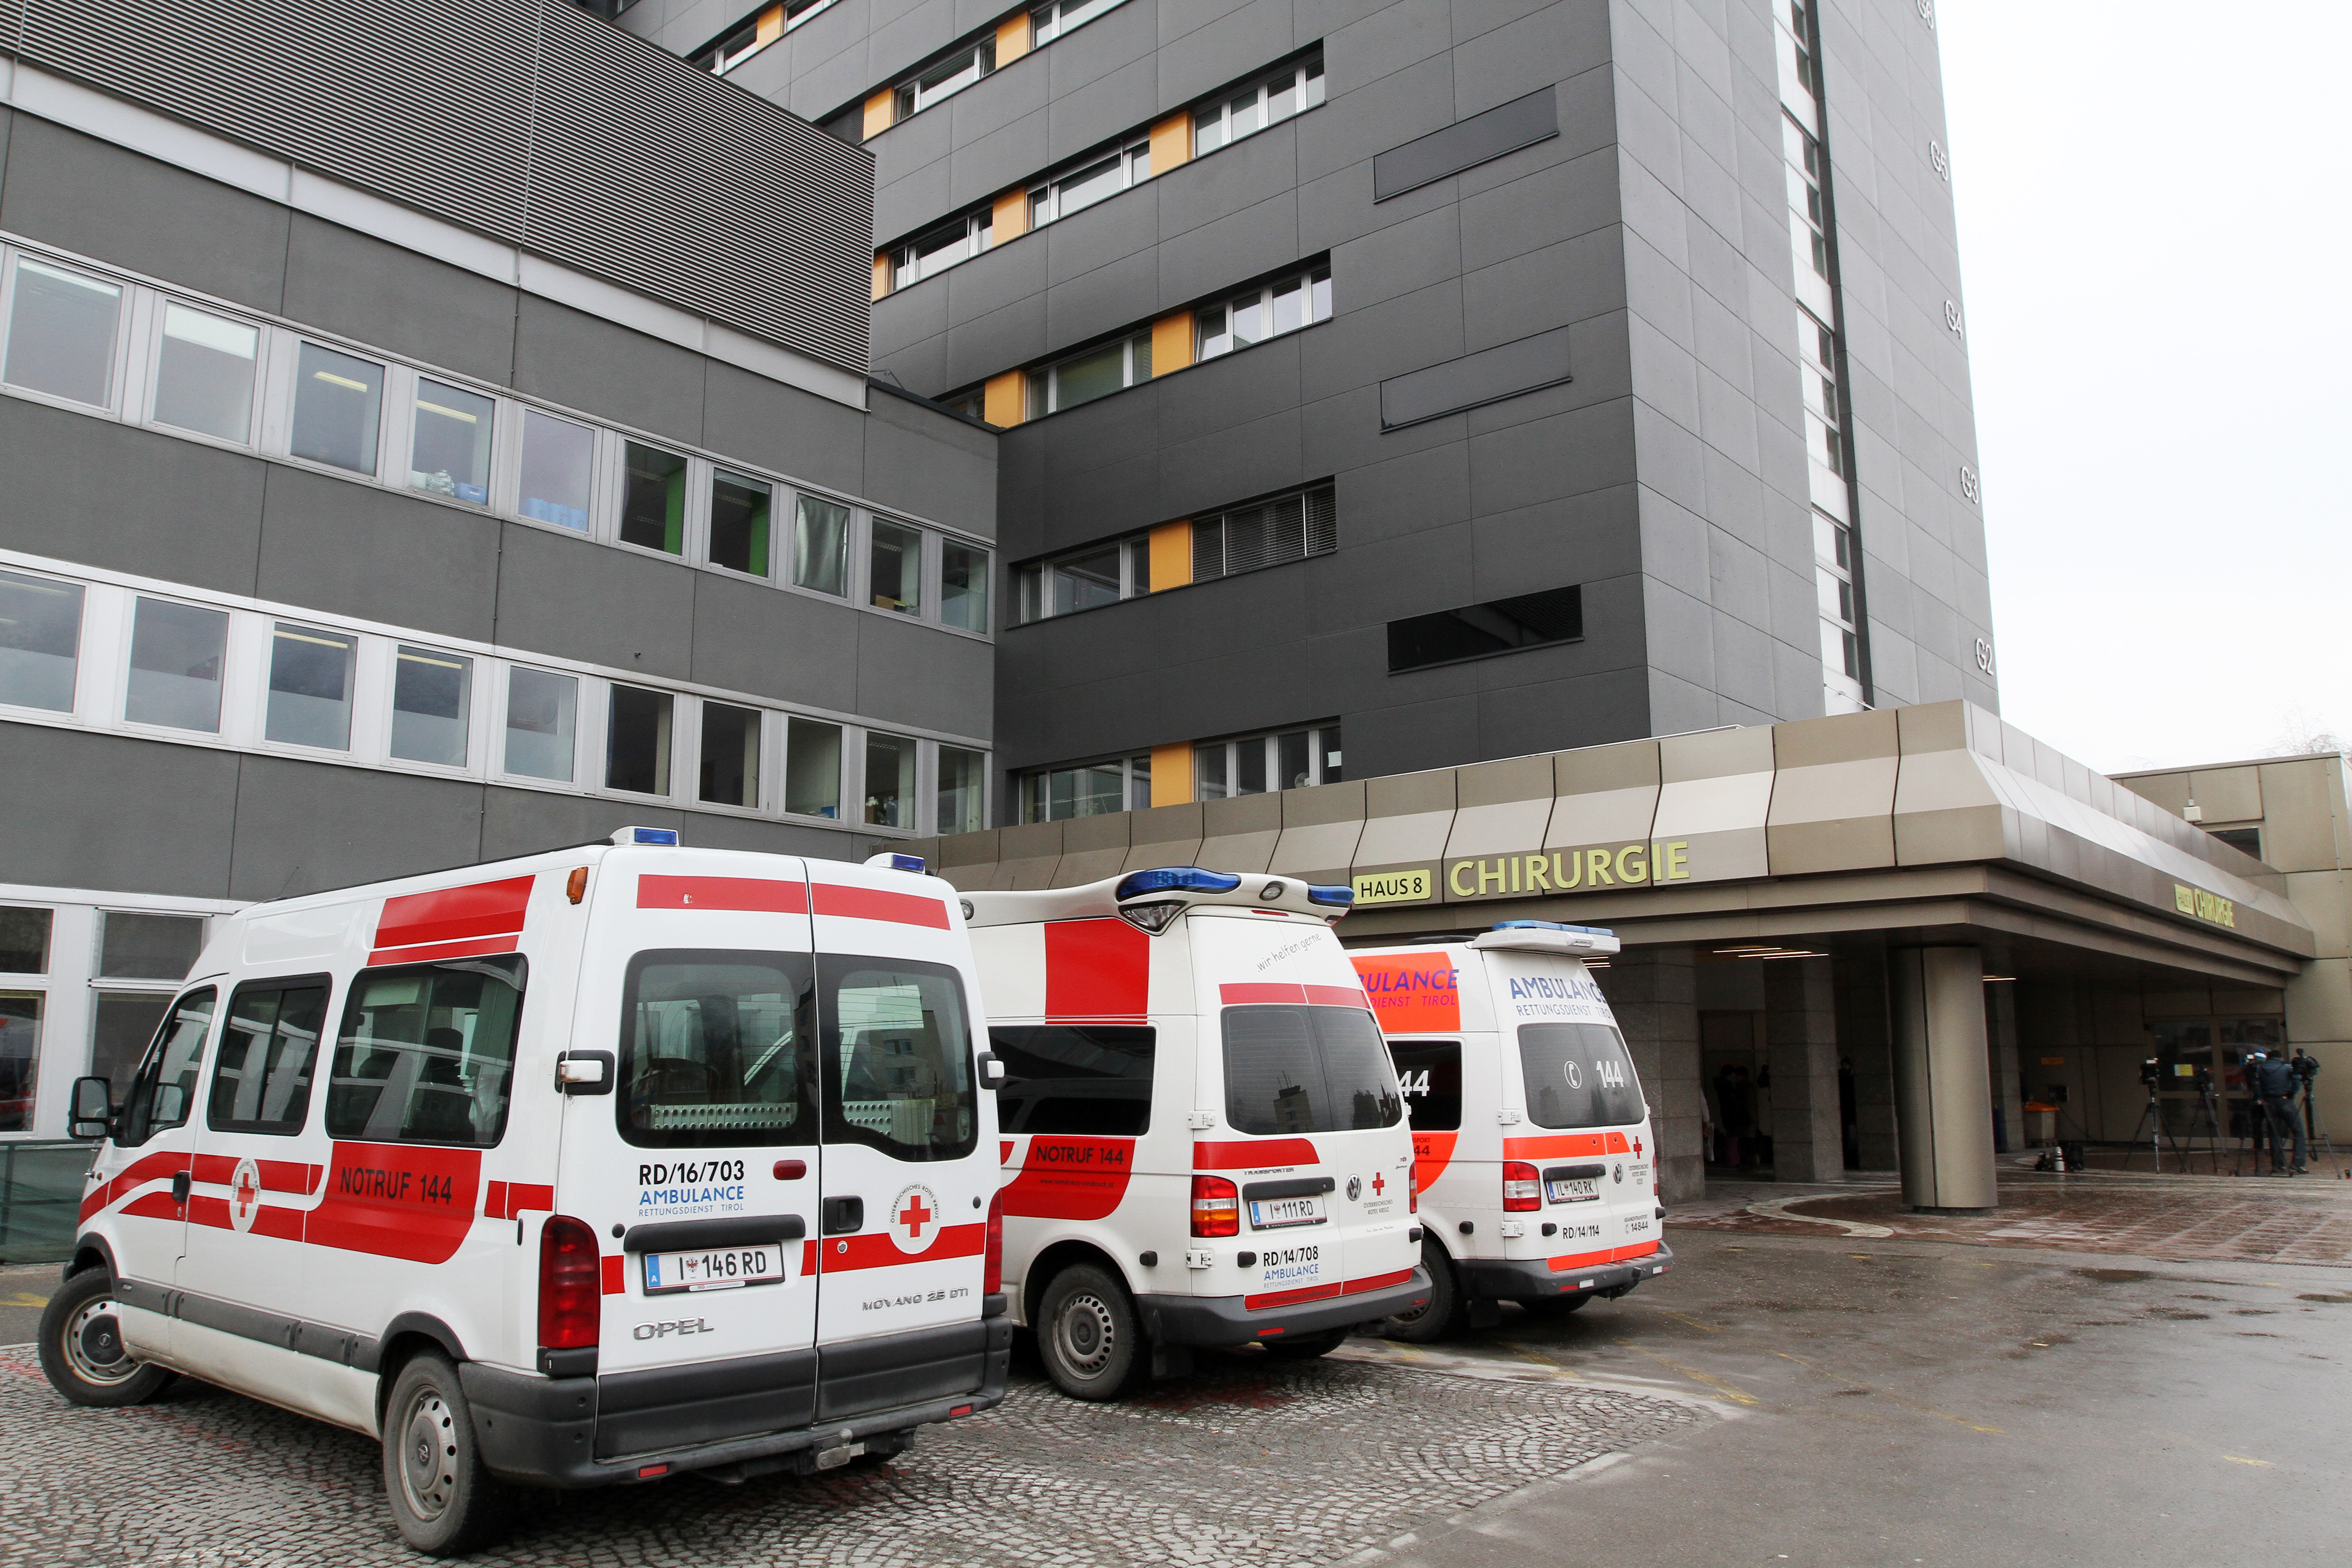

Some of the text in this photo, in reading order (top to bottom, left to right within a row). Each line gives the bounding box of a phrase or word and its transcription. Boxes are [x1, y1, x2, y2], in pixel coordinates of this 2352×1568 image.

[1930, 141, 1948, 181] G5
[1945, 300, 1962, 339] G4
[1961, 466, 1979, 504] G3
[1975, 638, 1994, 676] G2
[1450, 841, 1690, 897] CHIRURGIE
[1361, 877, 1422, 897] HAUS 8
[1271, 944, 1301, 962] helfen
[1300, 933, 1322, 951] gerne
[1422, 995, 1456, 1006] TIROL
[1509, 977, 1607, 1004] AMBULANCE
[1516, 1004, 1592, 1016] RETTUNGSDIENST
[1596, 1060, 1624, 1088] 144
[1036, 1146, 1124, 1165] NOTRUF 144
[639, 1160, 744, 1186] RD/16/703
[340, 1166, 452, 1205] NOTRUF 144
[639, 1186, 744, 1205] AMBULANCE
[1556, 1180, 1594, 1196] IL 140 RK
[639, 1203, 744, 1217] RETTUNGSDIENST TIROL
[890, 1184, 921, 1223] ÖSTERREICHISCHES
[922, 1186, 935, 1199] ROTES
[1270, 1200, 1313, 1220] I 111 RD
[1363, 1199, 1393, 1208] ÖSTERREICHISCHES
[1563, 1225, 1600, 1240] RD/14/114
[1631, 1221, 1648, 1232] 14844
[679, 1251, 767, 1280] I 146 RD
[1264, 1246, 1318, 1267] RD/14/708
[651, 1274, 658, 1283] A
[1264, 1264, 1319, 1281] AMBULANCE
[1264, 1278, 1303, 1289] RETTUNGSDIENST
[862, 1293, 922, 1311] MOVANO
[950, 1287, 969, 1298] DTI
[634, 1316, 715, 1340] OPEL
